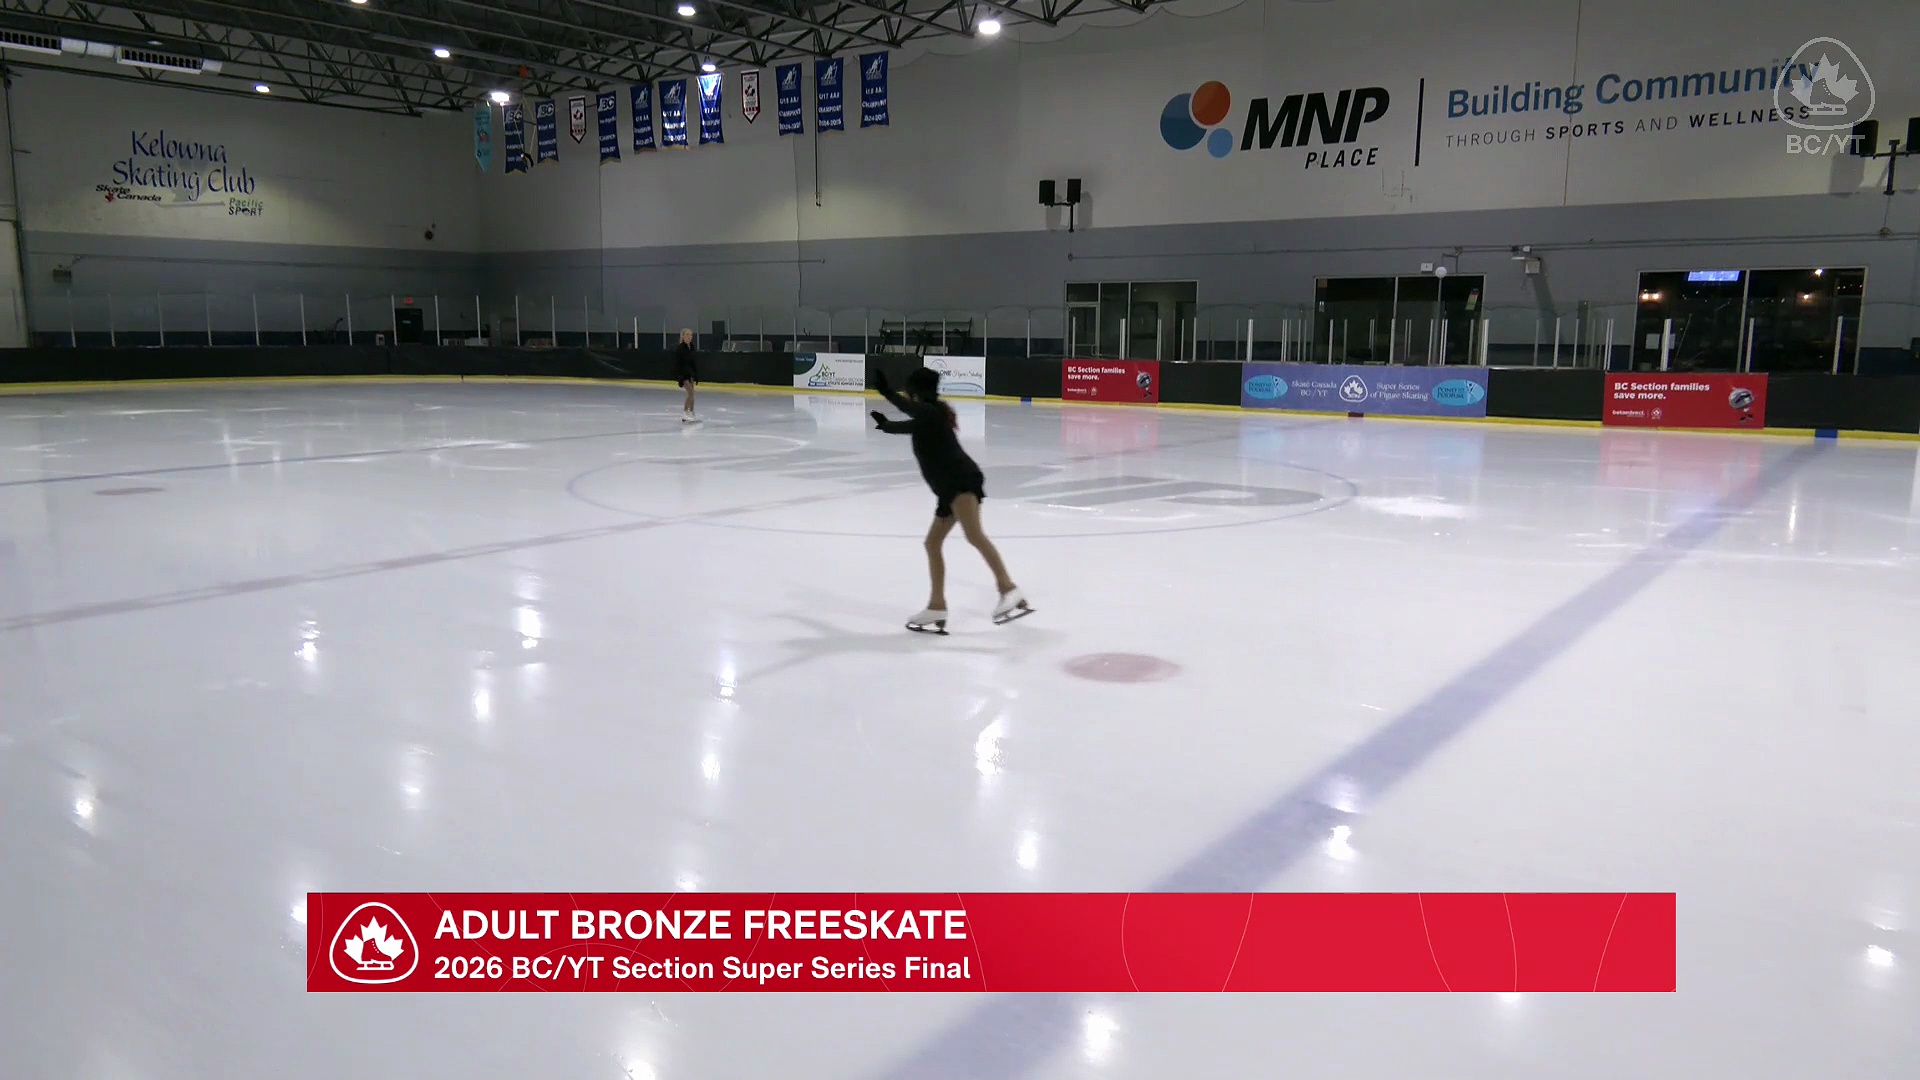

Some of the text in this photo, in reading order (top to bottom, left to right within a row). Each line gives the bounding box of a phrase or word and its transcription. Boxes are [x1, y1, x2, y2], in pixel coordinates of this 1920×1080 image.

[1447, 57, 1821, 118] Building Community
[1240, 86, 1390, 151] MNP
[1445, 105, 1811, 148] THROUGH SPORTS AND WELLNESS
[131, 129, 228, 164] Kelowna
[1305, 147, 1379, 169] PLACE
[112, 157, 255, 202] Skating Club
[1078, 366, 1101, 374] Section
[1101, 366, 1126, 375] families
[1614, 382, 1711, 391] BC Section families
[1613, 391, 1667, 400] save more.
